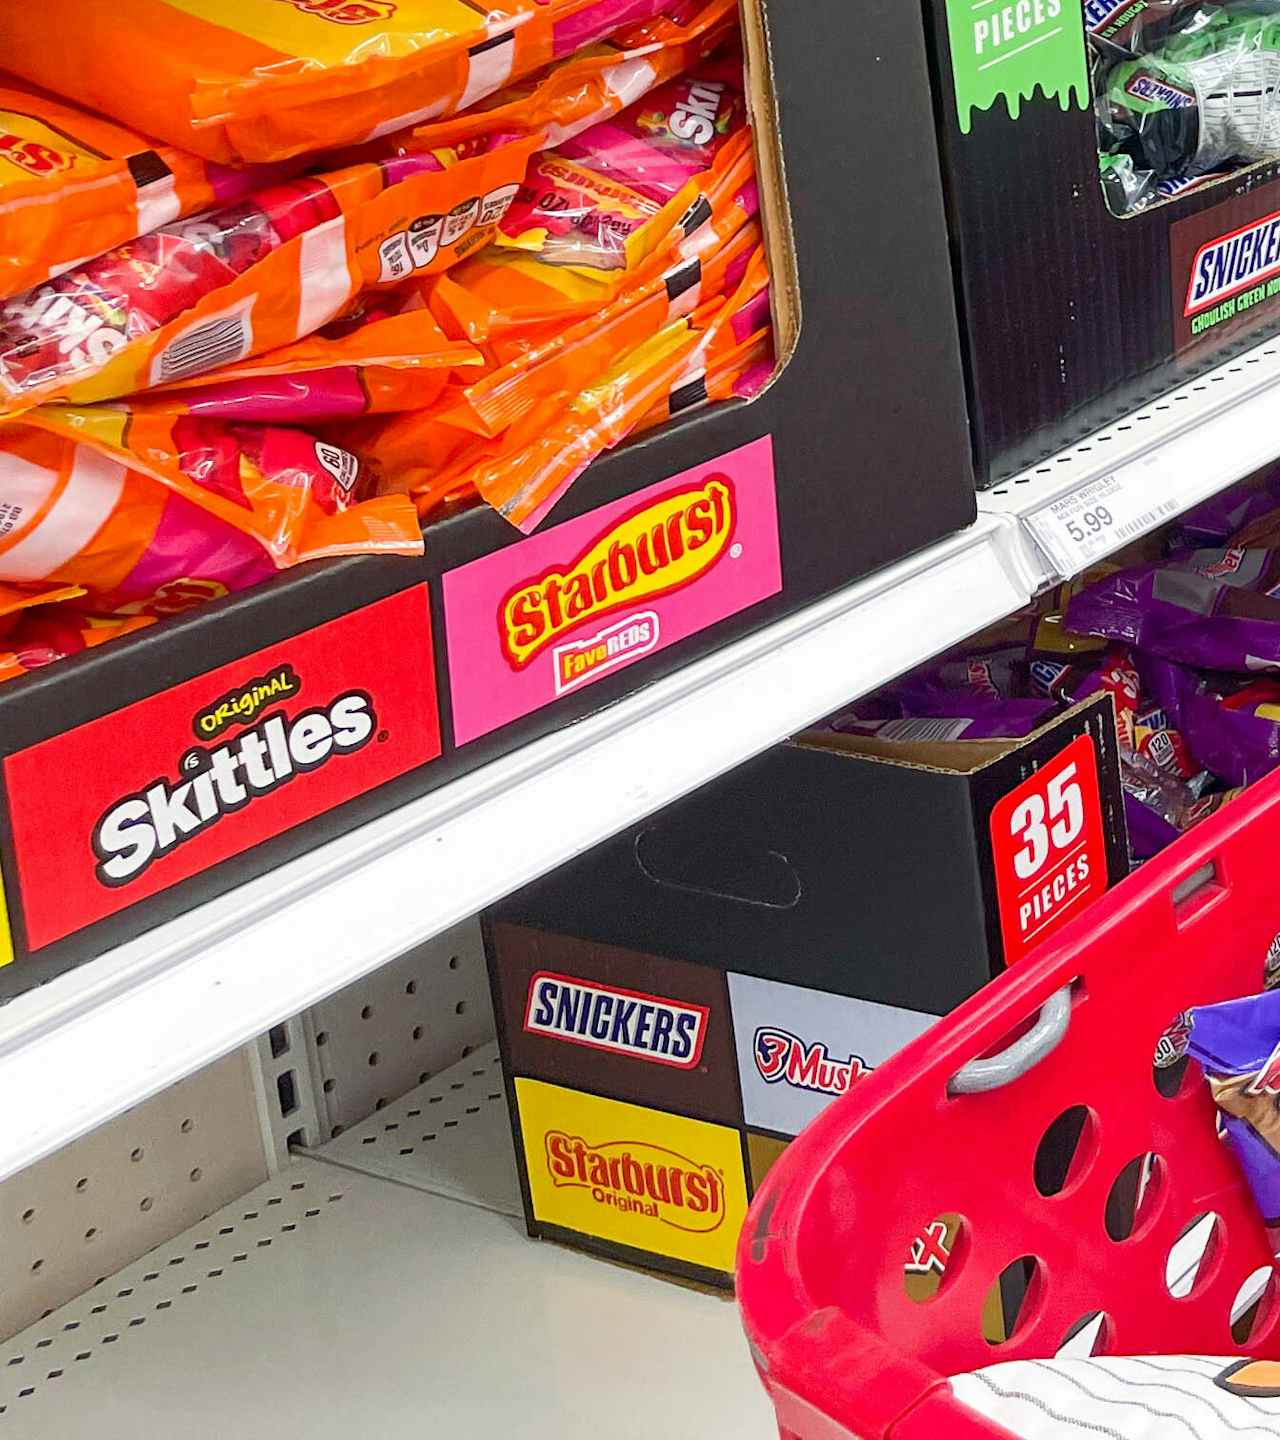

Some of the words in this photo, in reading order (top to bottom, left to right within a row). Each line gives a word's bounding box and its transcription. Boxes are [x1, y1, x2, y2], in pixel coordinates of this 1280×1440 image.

[1191, 296, 1236, 335] GHOULISH
[1236, 284, 1266, 314] GREEN
[1050, 495, 1079, 513] MARS
[1066, 505, 1113, 542] 5.99
[511, 486, 724, 648] Starburst
[1149, 734, 1170, 755] 120
[99, 695, 374, 879] Skittles
[1010, 761, 1084, 879] 35
[1018, 853, 1090, 932] PIECES
[534, 981, 697, 1059] SNICKERS
[758, 1033, 786, 1078] 3
[550, 1134, 720, 1213] Starburst
[591, 1186, 659, 1219] Original
